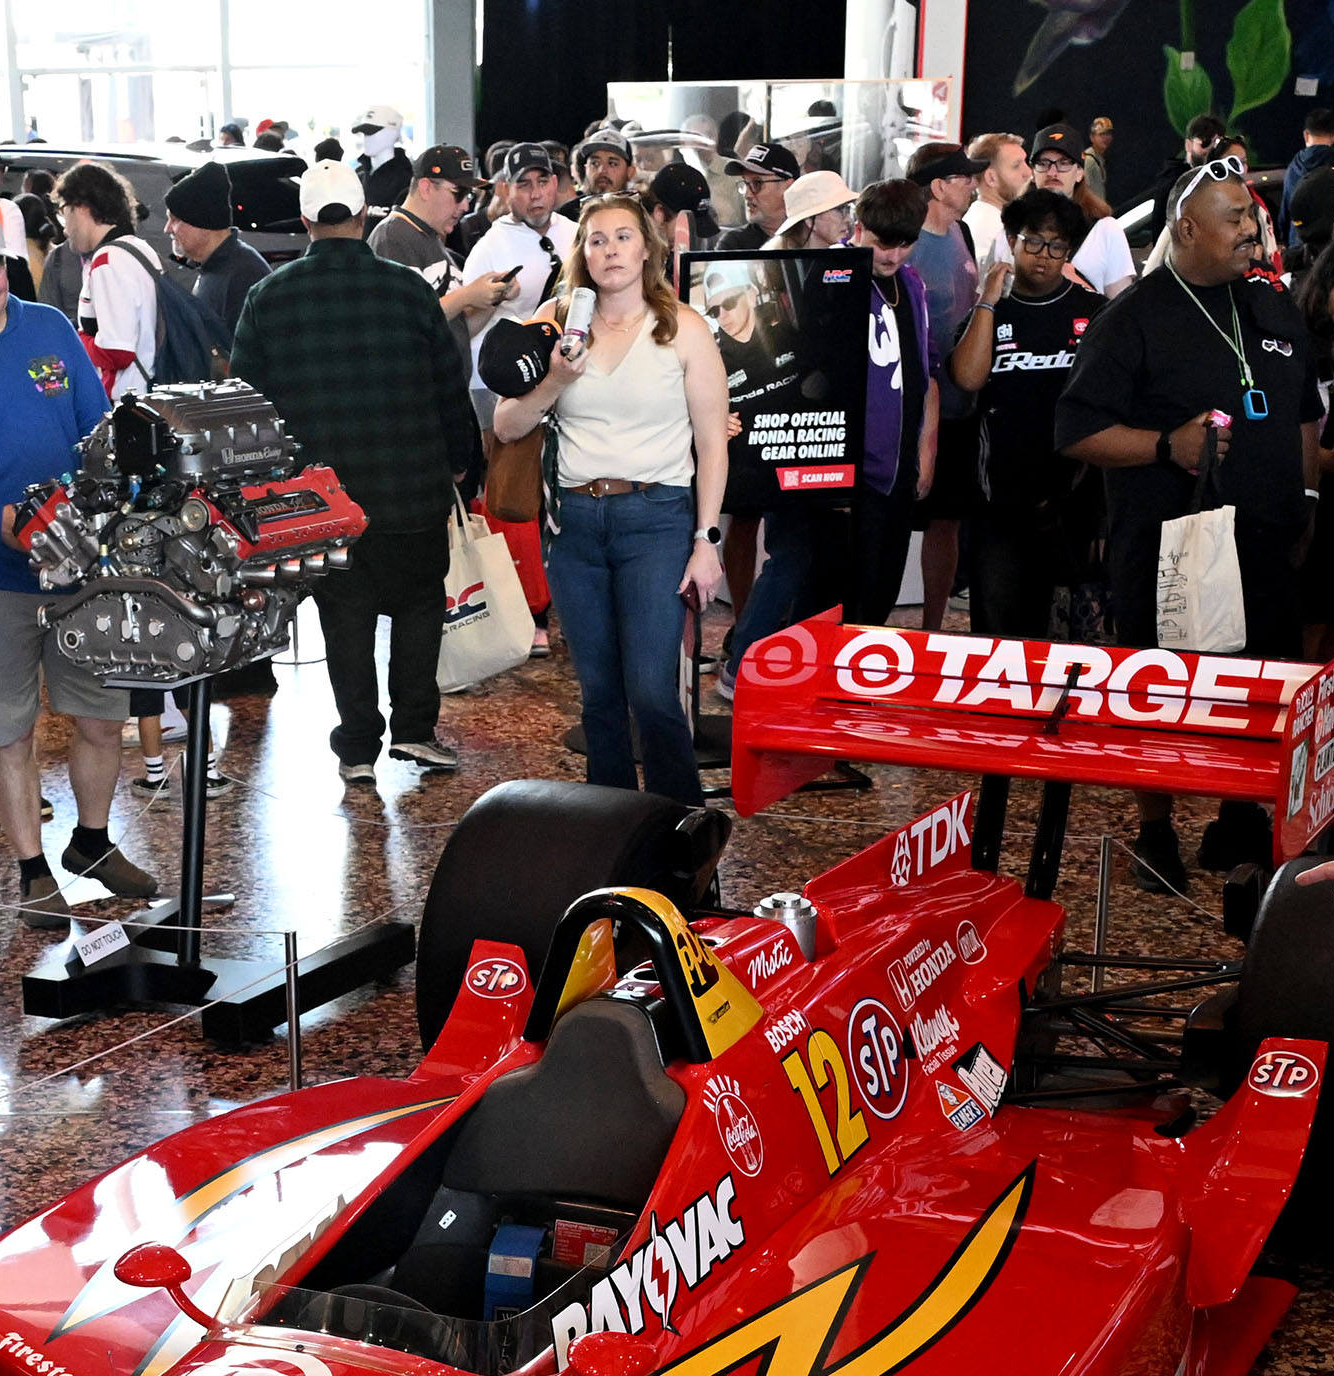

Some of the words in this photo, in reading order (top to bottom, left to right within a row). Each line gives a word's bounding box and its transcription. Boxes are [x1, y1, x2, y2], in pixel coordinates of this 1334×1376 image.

[748, 430, 795, 445] HONDA
[797, 427, 846, 444] RACING
[754, 414, 790, 429] SHOP
[791, 411, 846, 427] OFFICIAL
[761, 446, 795, 461] GEAR
[796, 443, 846, 460] ONLINE
[801, 473, 823, 484] SCAN
[823, 472, 844, 483] NOW
[449, 610, 491, 632] RACING
[924, 633, 1327, 734] TARGET
[909, 793, 971, 876] TDK
[81, 944, 92, 956] DO
[91, 938, 104, 950] NOT
[102, 928, 123, 944] TOUCH
[473, 964, 520, 993] STP
[747, 938, 793, 989] Mistic
[909, 940, 957, 998] HONDA
[764, 1008, 807, 1053] BOSCH
[859, 1013, 900, 1097] STP
[921, 1055, 942, 1078] Facial
[936, 1044, 958, 1065] Tissue
[1253, 1057, 1309, 1088] STP
[703, 1073, 741, 1112] ALWAYS
[781, 1027, 869, 1179] 12
[950, 1100, 983, 1130] ELMER'S
